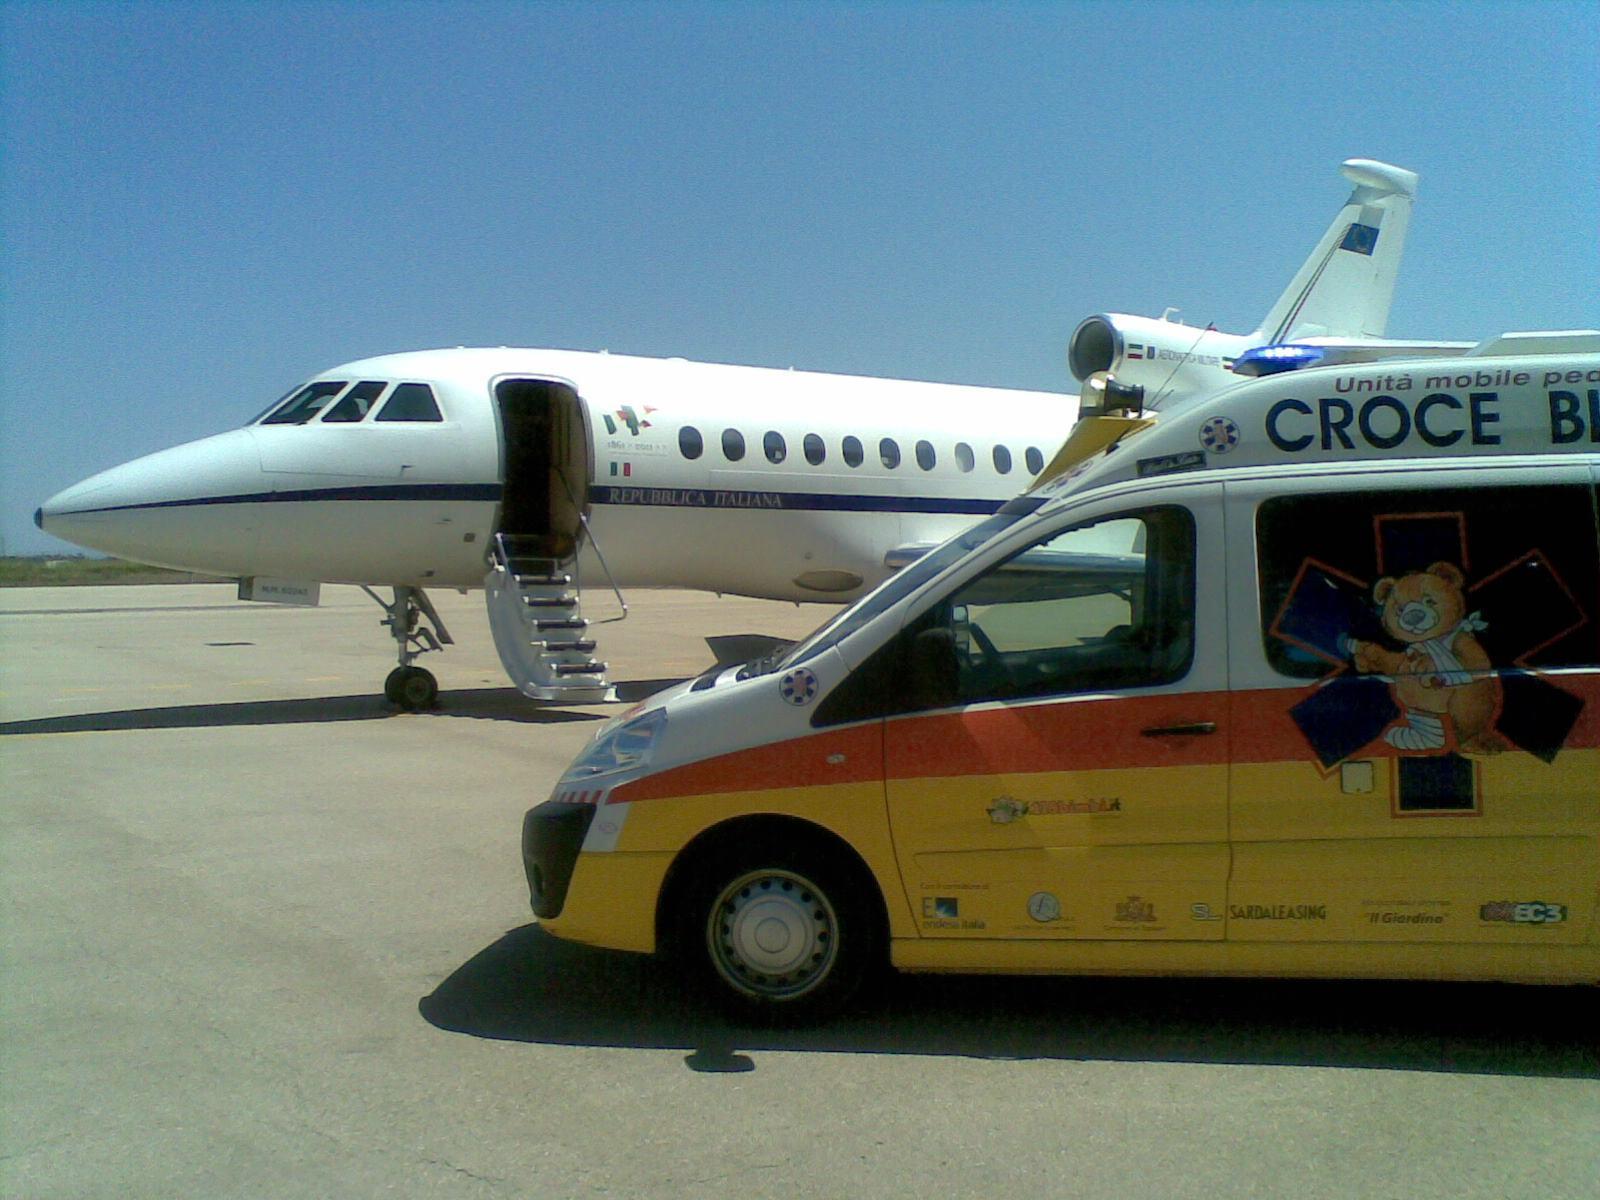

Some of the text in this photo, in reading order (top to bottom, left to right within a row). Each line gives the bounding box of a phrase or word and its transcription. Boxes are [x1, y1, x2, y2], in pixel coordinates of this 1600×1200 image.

[1334, 373, 1413, 393] Unità
[1424, 369, 1531, 390] mobile
[1265, 392, 1501, 452] CROCE
[609, 487, 783, 508] REPUBBLICA ITALIANA
[1230, 903, 1327, 920] SARDALEASING
